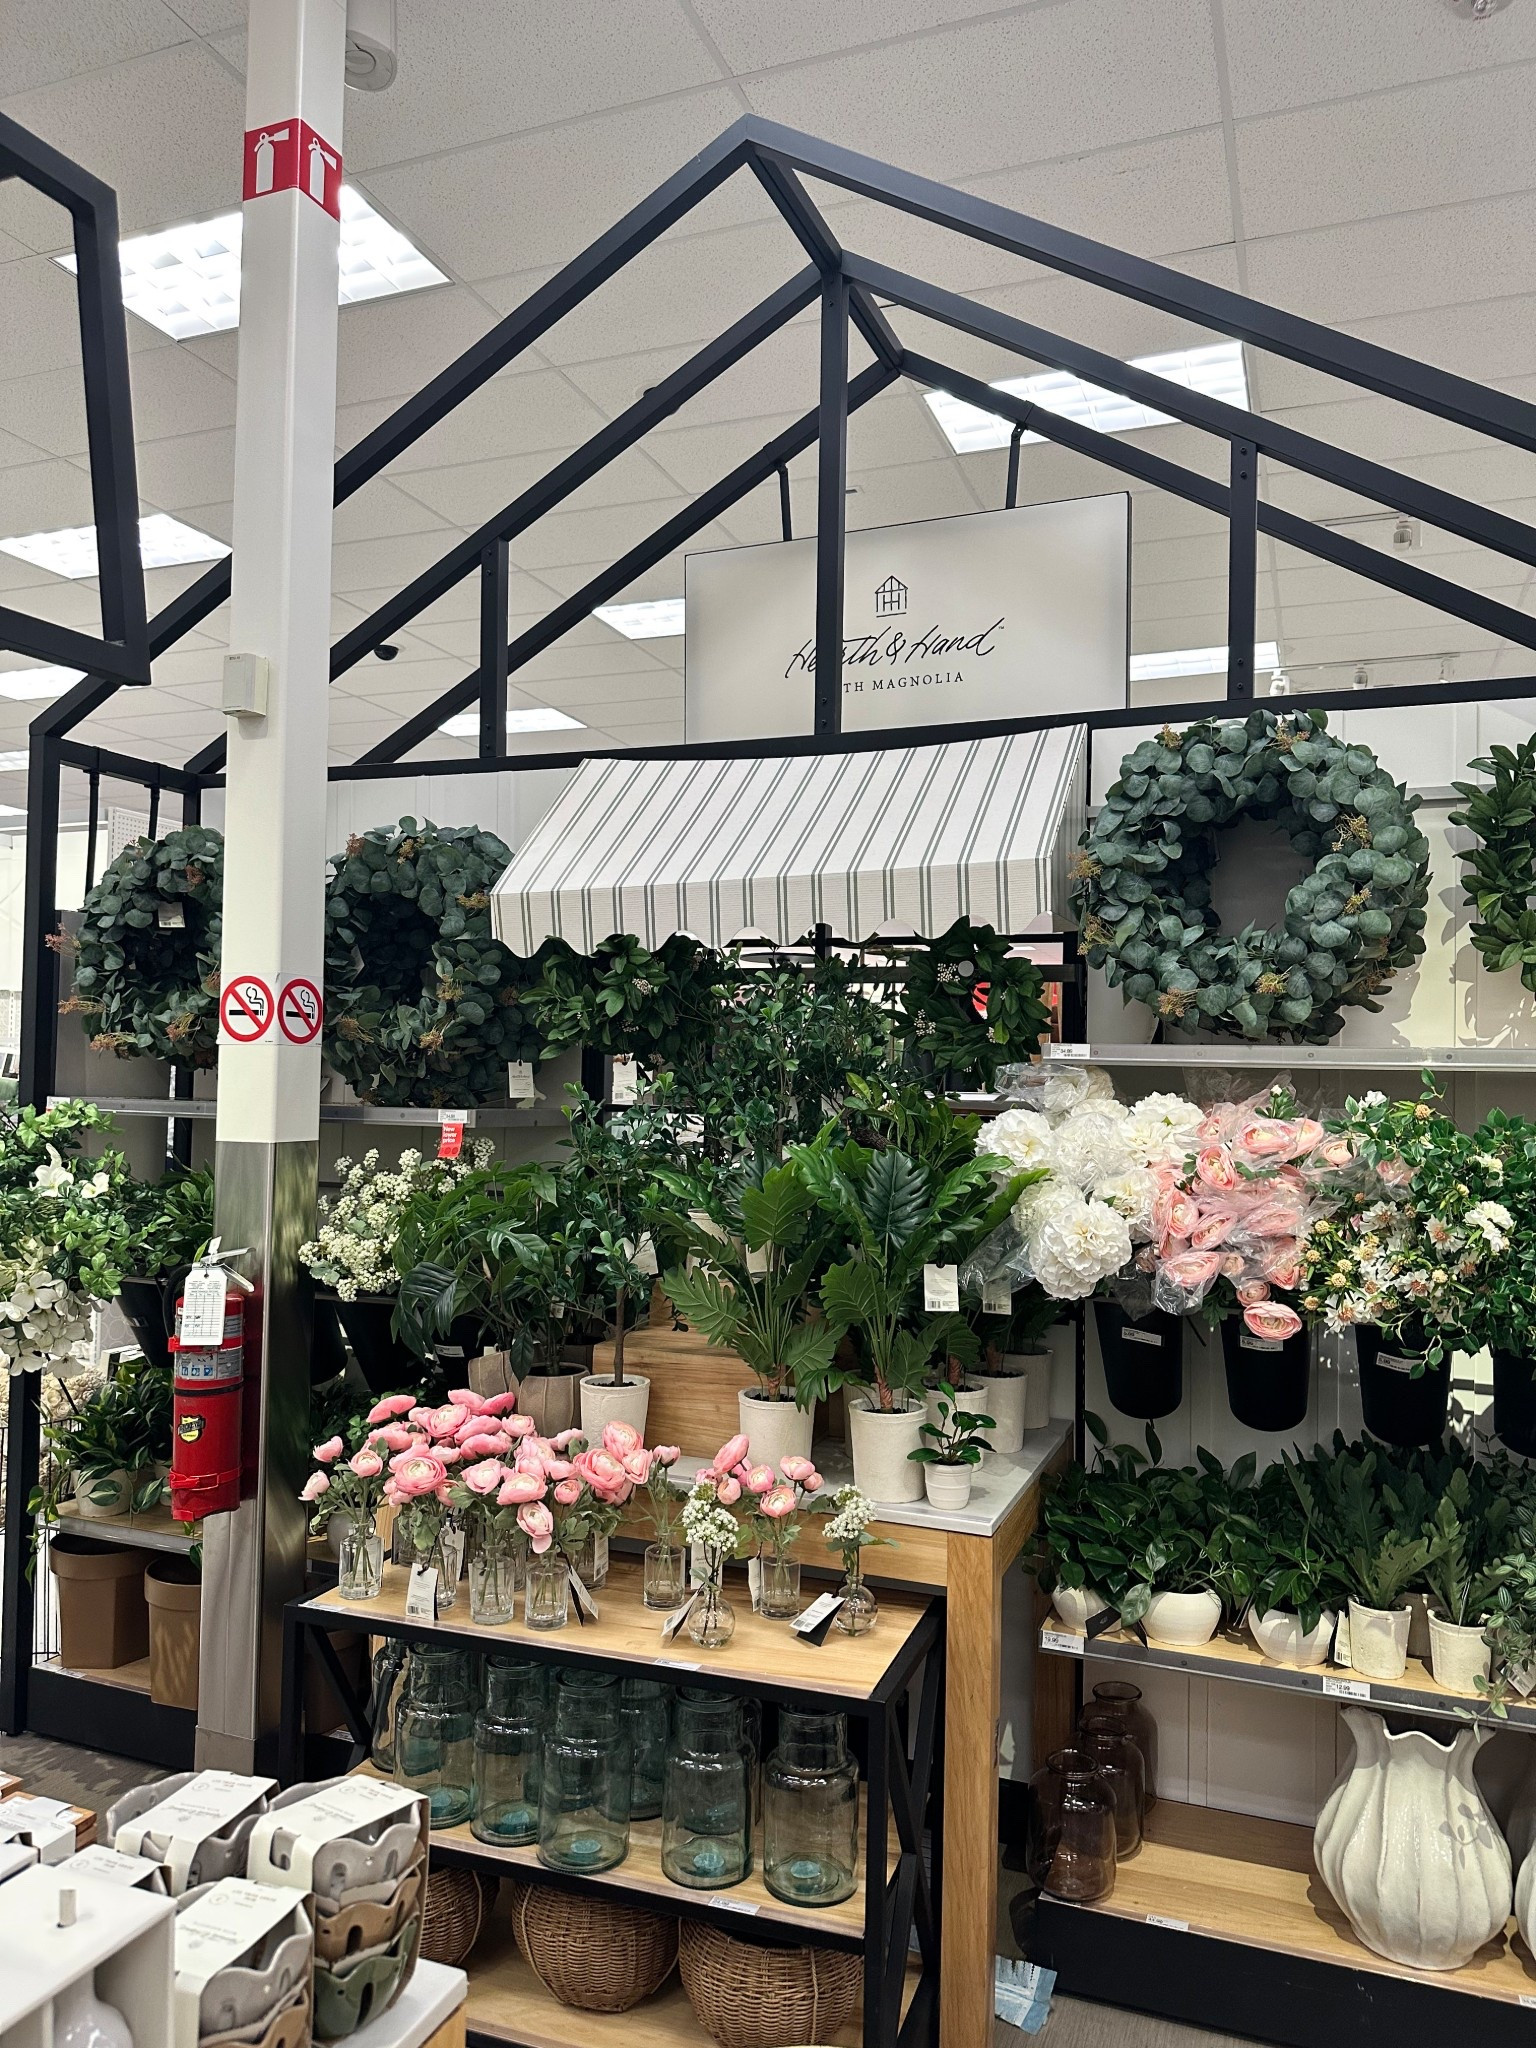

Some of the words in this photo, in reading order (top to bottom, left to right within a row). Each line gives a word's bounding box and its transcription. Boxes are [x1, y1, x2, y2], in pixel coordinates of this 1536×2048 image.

[886, 631, 907, 666] &
[905, 617, 1005, 664] Hand
[872, 671, 964, 691] MAGNOLIA
